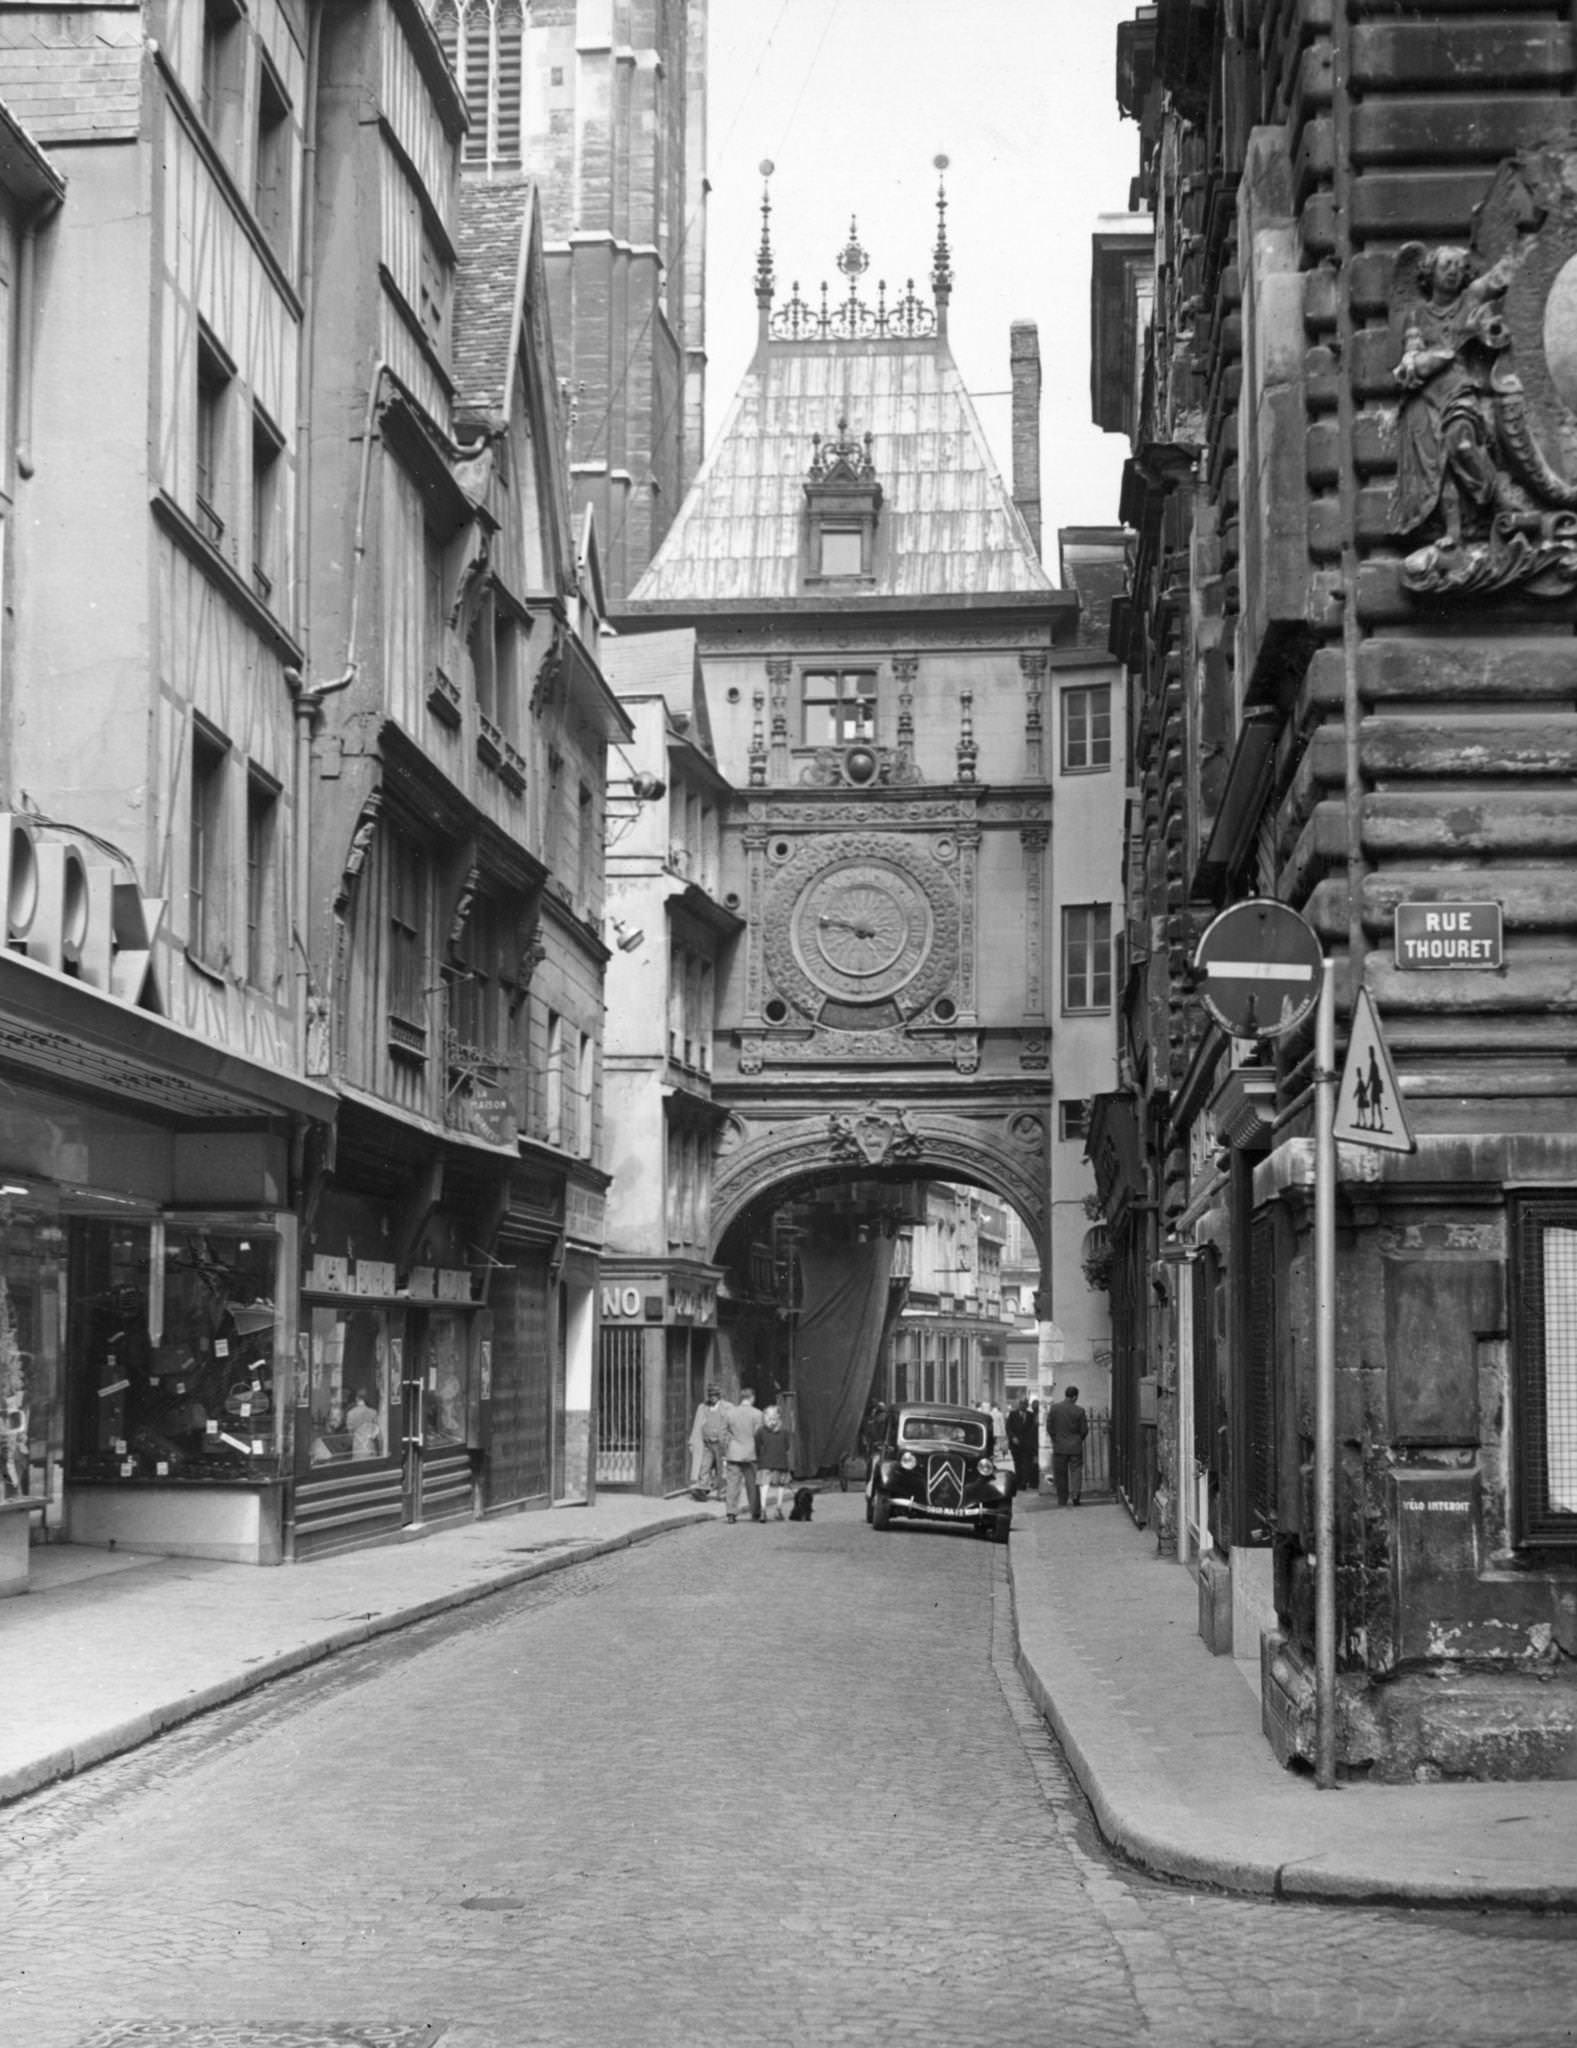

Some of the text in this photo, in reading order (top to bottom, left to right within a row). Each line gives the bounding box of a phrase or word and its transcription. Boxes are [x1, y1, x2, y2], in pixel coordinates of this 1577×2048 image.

[1426, 912, 1472, 931] RUE
[1404, 939, 1493, 958] THOURET
[470, 1101, 507, 1110] MAISON
